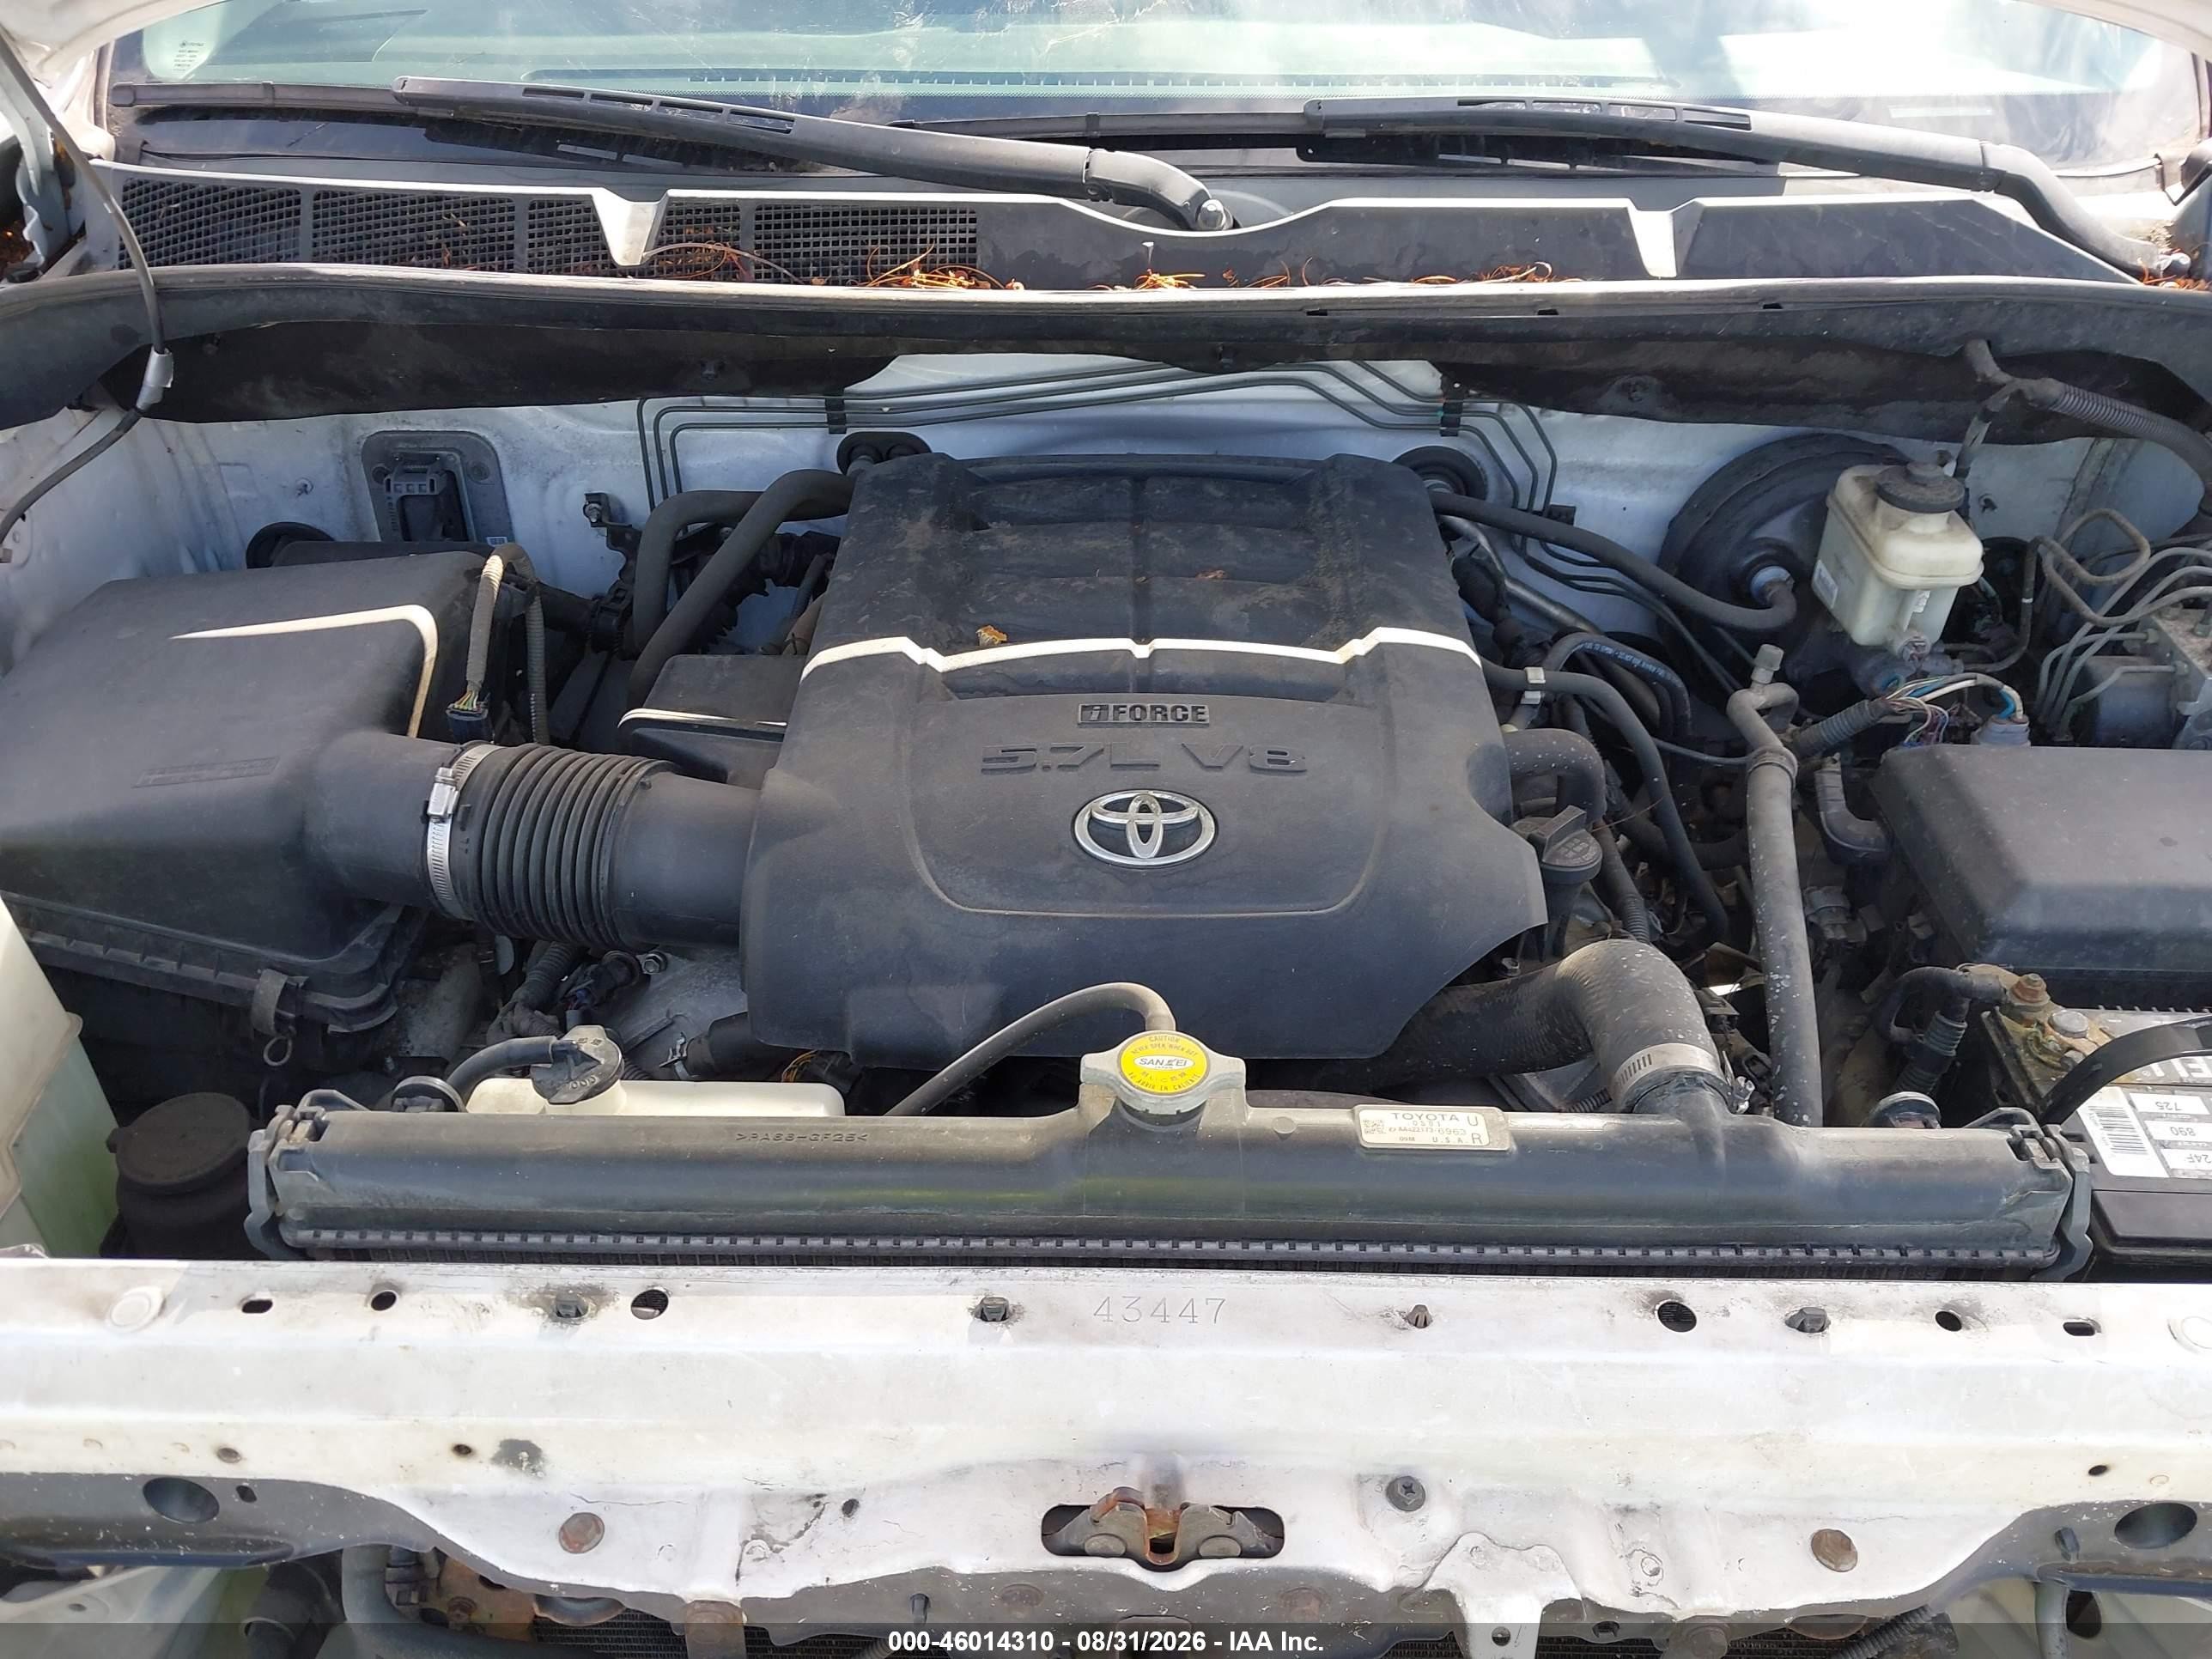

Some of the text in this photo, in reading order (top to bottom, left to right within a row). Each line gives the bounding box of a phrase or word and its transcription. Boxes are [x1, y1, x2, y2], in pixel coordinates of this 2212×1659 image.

[981, 742, 1308, 775] 5.7L V8
[2155, 1101, 2183, 1111] 725
[1391, 1112, 1479, 1127] TOYOTA U
[1471, 1132, 1484, 1146] R
[2170, 1127, 2197, 1137] 890
[1093, 1296, 1226, 1324] 43447
